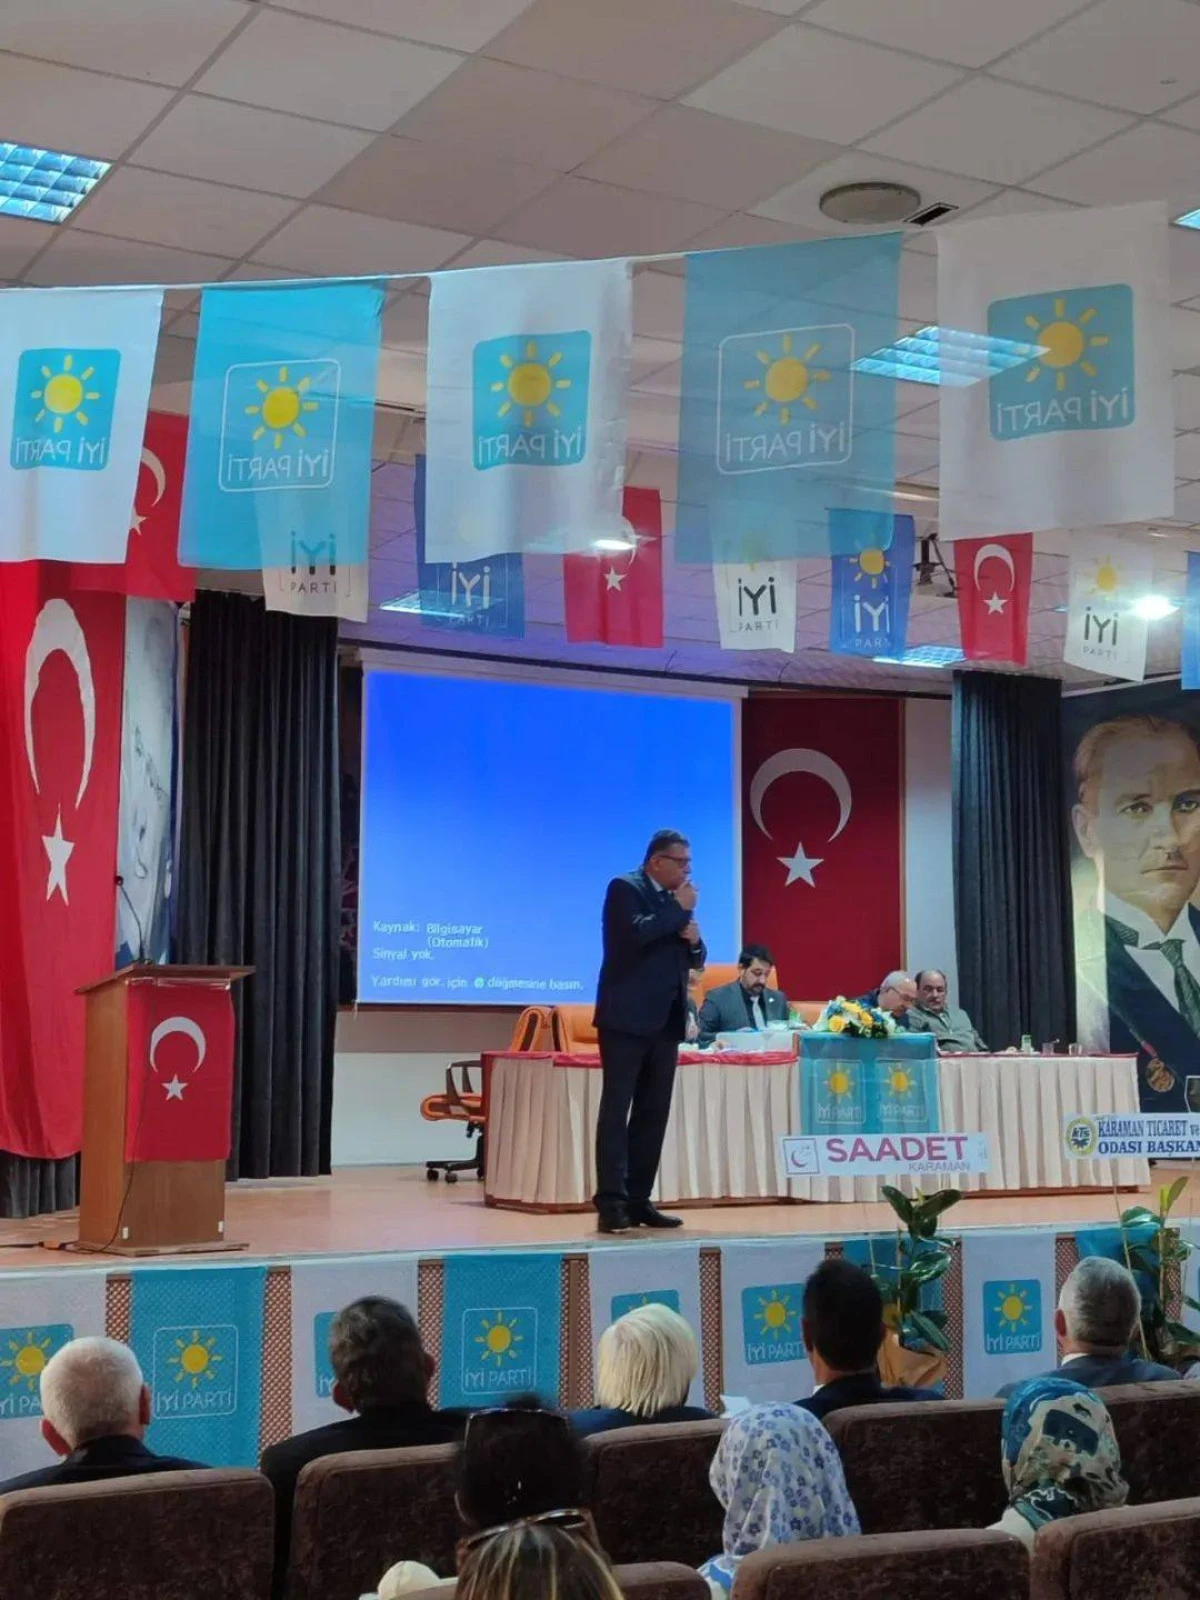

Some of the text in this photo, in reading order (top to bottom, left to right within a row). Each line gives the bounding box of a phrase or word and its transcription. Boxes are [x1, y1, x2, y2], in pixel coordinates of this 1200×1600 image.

[290, 530, 336, 576] İYİ
[451, 561, 491, 609] İYİ
[738, 576, 776, 616] İYİ
[854, 594, 890, 633] İYİ
[1084, 606, 1119, 646] İYİ
[1098, 1119, 1145, 1138] KARAMAN
[826, 1136, 968, 1162] SAADET
[1098, 1141, 1143, 1154] ODASI
[909, 1161, 971, 1172] KARAMAN
[769, 1341, 804, 1360] PART
